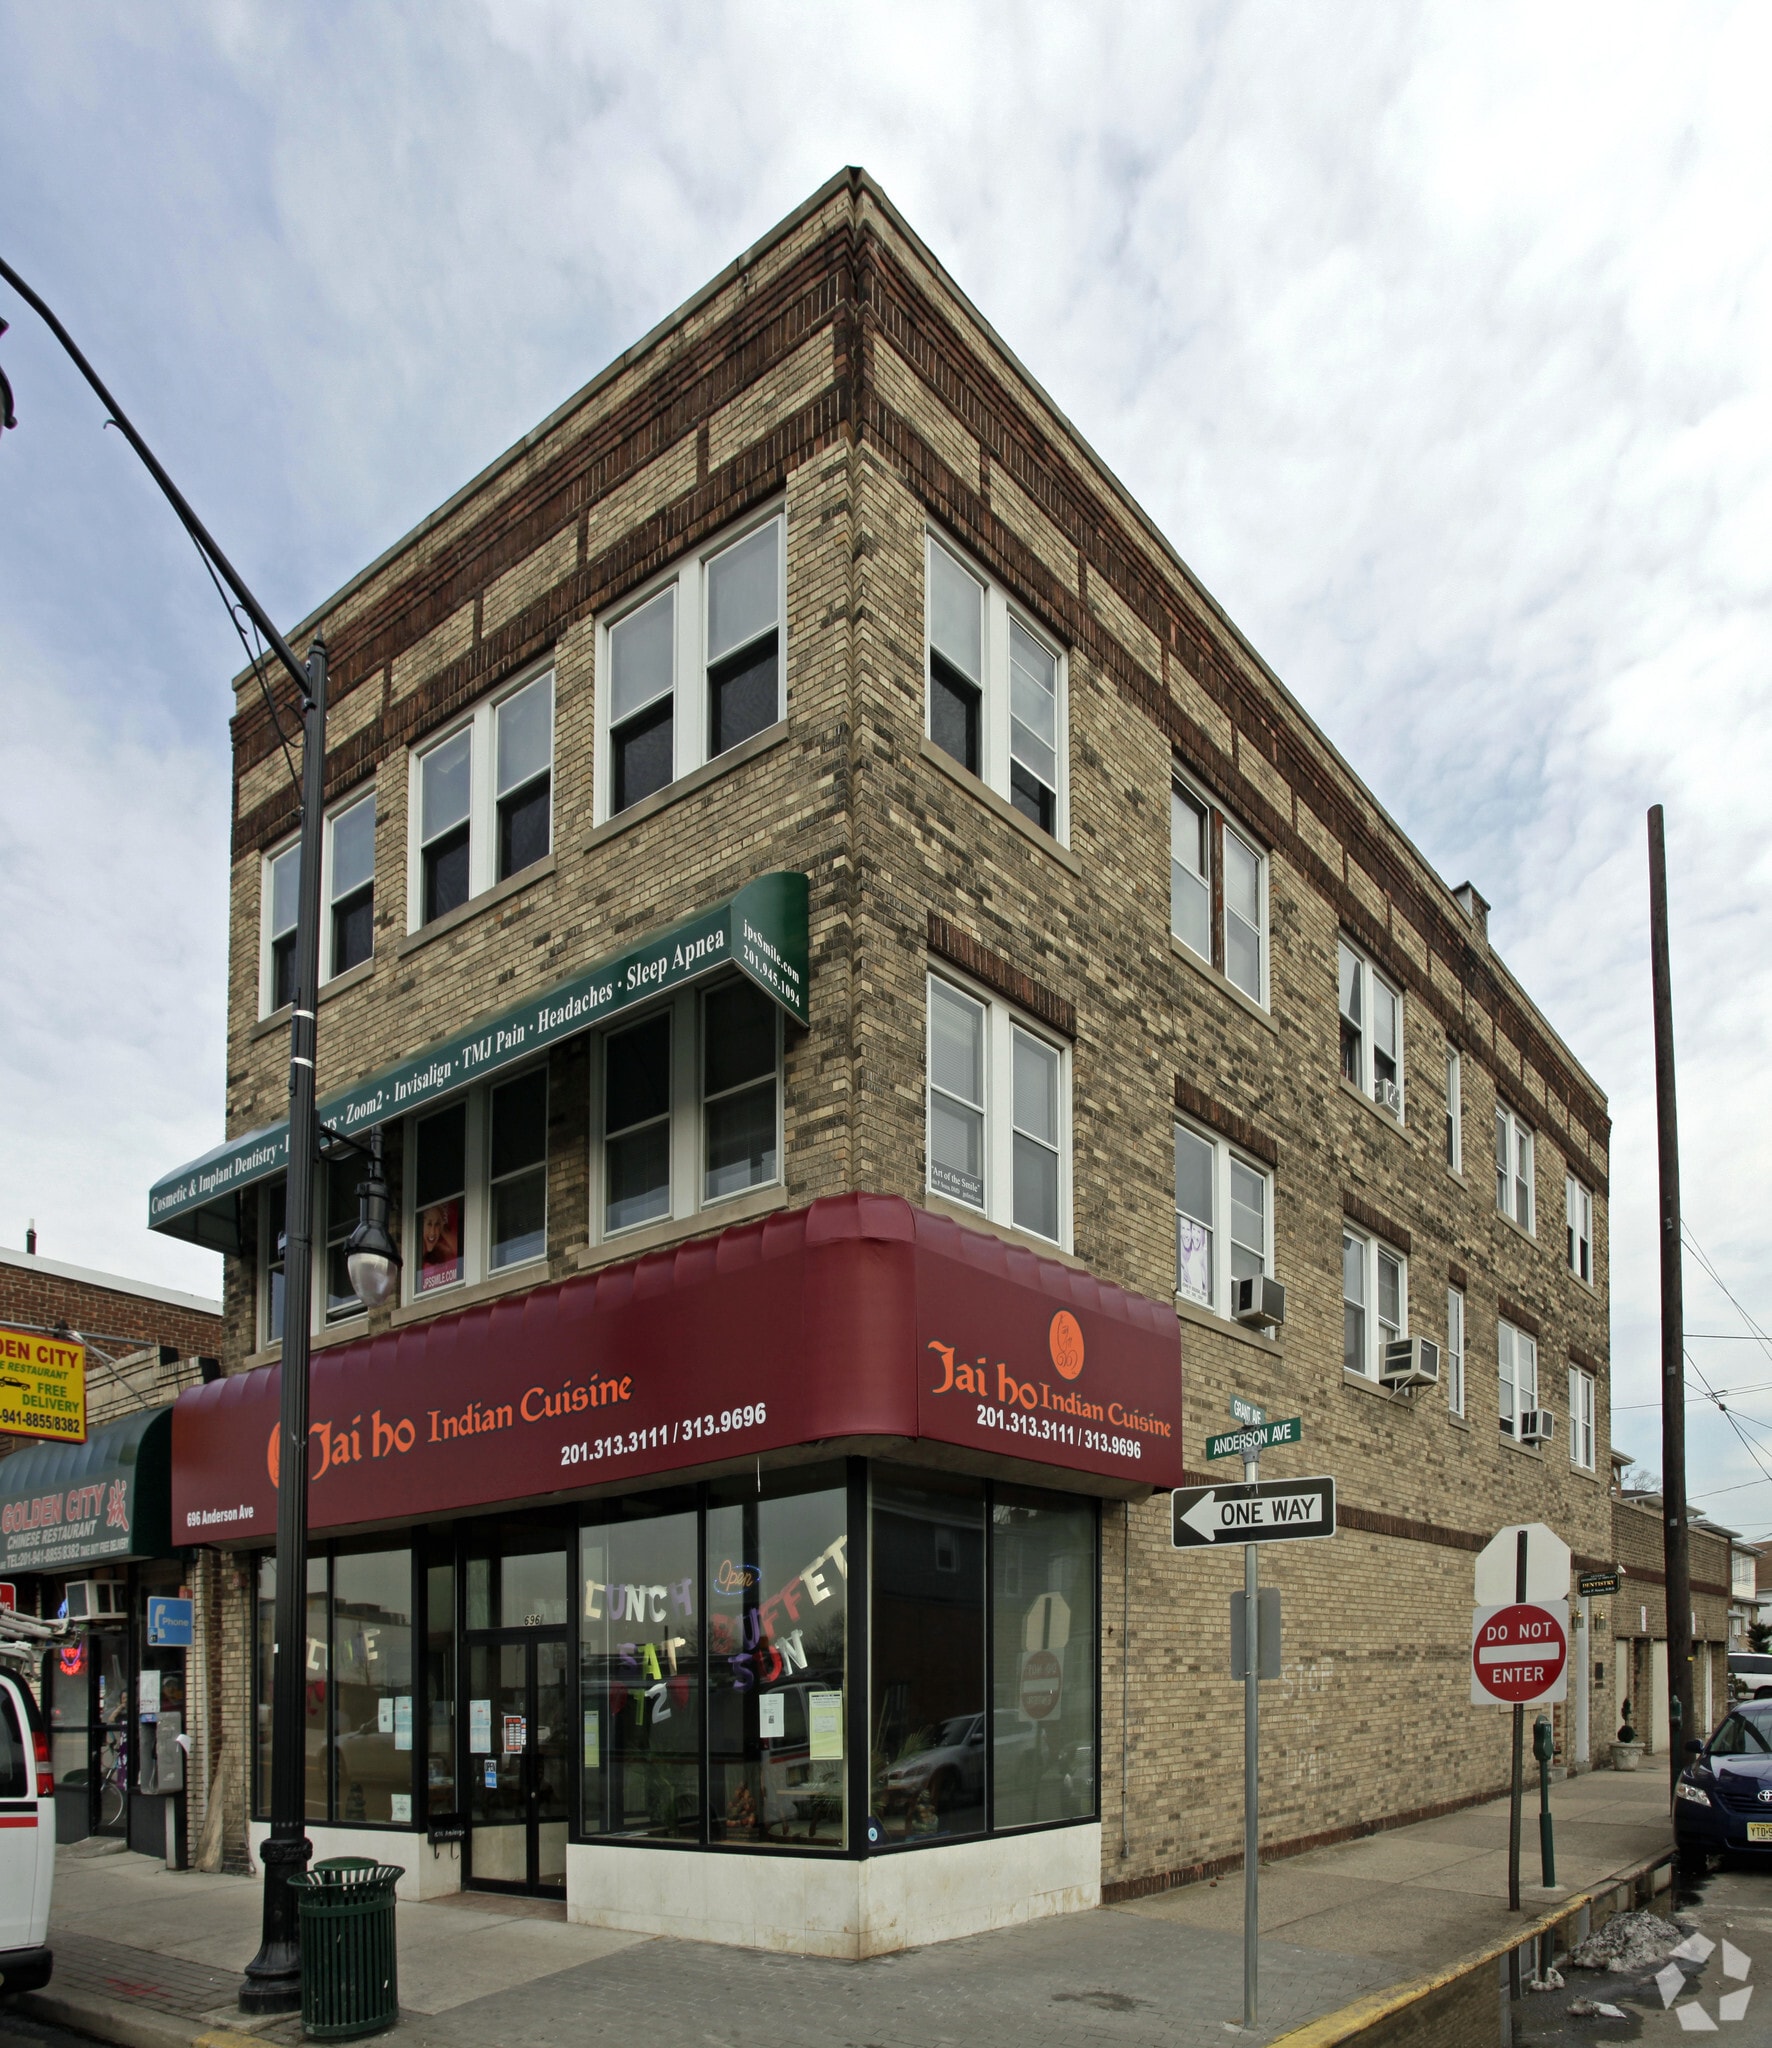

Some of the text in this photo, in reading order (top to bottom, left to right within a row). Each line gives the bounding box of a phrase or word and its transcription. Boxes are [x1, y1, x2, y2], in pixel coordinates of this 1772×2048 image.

[743, 919, 800, 984] jpsSmile.com
[743, 945, 800, 1007] 201.945.1094
[151, 929, 724, 1214] Cosmetic & Implant Dentistry Zoom2 Invisalign TMJ Pain Headaches Sleep Apnea
[944, 1172, 952, 1181] of
[951, 1174, 961, 1185] the
[37, 1345, 79, 1368] CITY
[7, 1361, 69, 1380] RESTAURANT
[37, 1382, 67, 1398] FREE
[928, 1341, 1172, 1438] Jai ho Indian Cuisine
[22, 1394, 80, 1413] DELIVERY
[1234, 1400, 1261, 1424] GRANT AVE
[308, 1373, 632, 1480] Jai ho Indian Cuisine
[1213, 1423, 1292, 1455] ANDERSON AVE
[1, 1482, 107, 1534] GOLDEN CITY
[186, 1504, 254, 1527] 696 Anderson Ave
[1221, 1497, 1315, 1526] ONE WAY
[7, 1520, 97, 1550] CHINESE RESTAURANT
[100, 1541, 110, 1553] FREE
[719, 1560, 753, 1591] Open
[585, 1578, 692, 1623] LUNCH
[162, 1616, 190, 1627] Phone
[524, 1615, 541, 1626] 696
[1486, 1622, 1552, 1641] DO NOT
[617, 1629, 808, 1691] SAT SUN
[1492, 1667, 1545, 1683] ENTER
